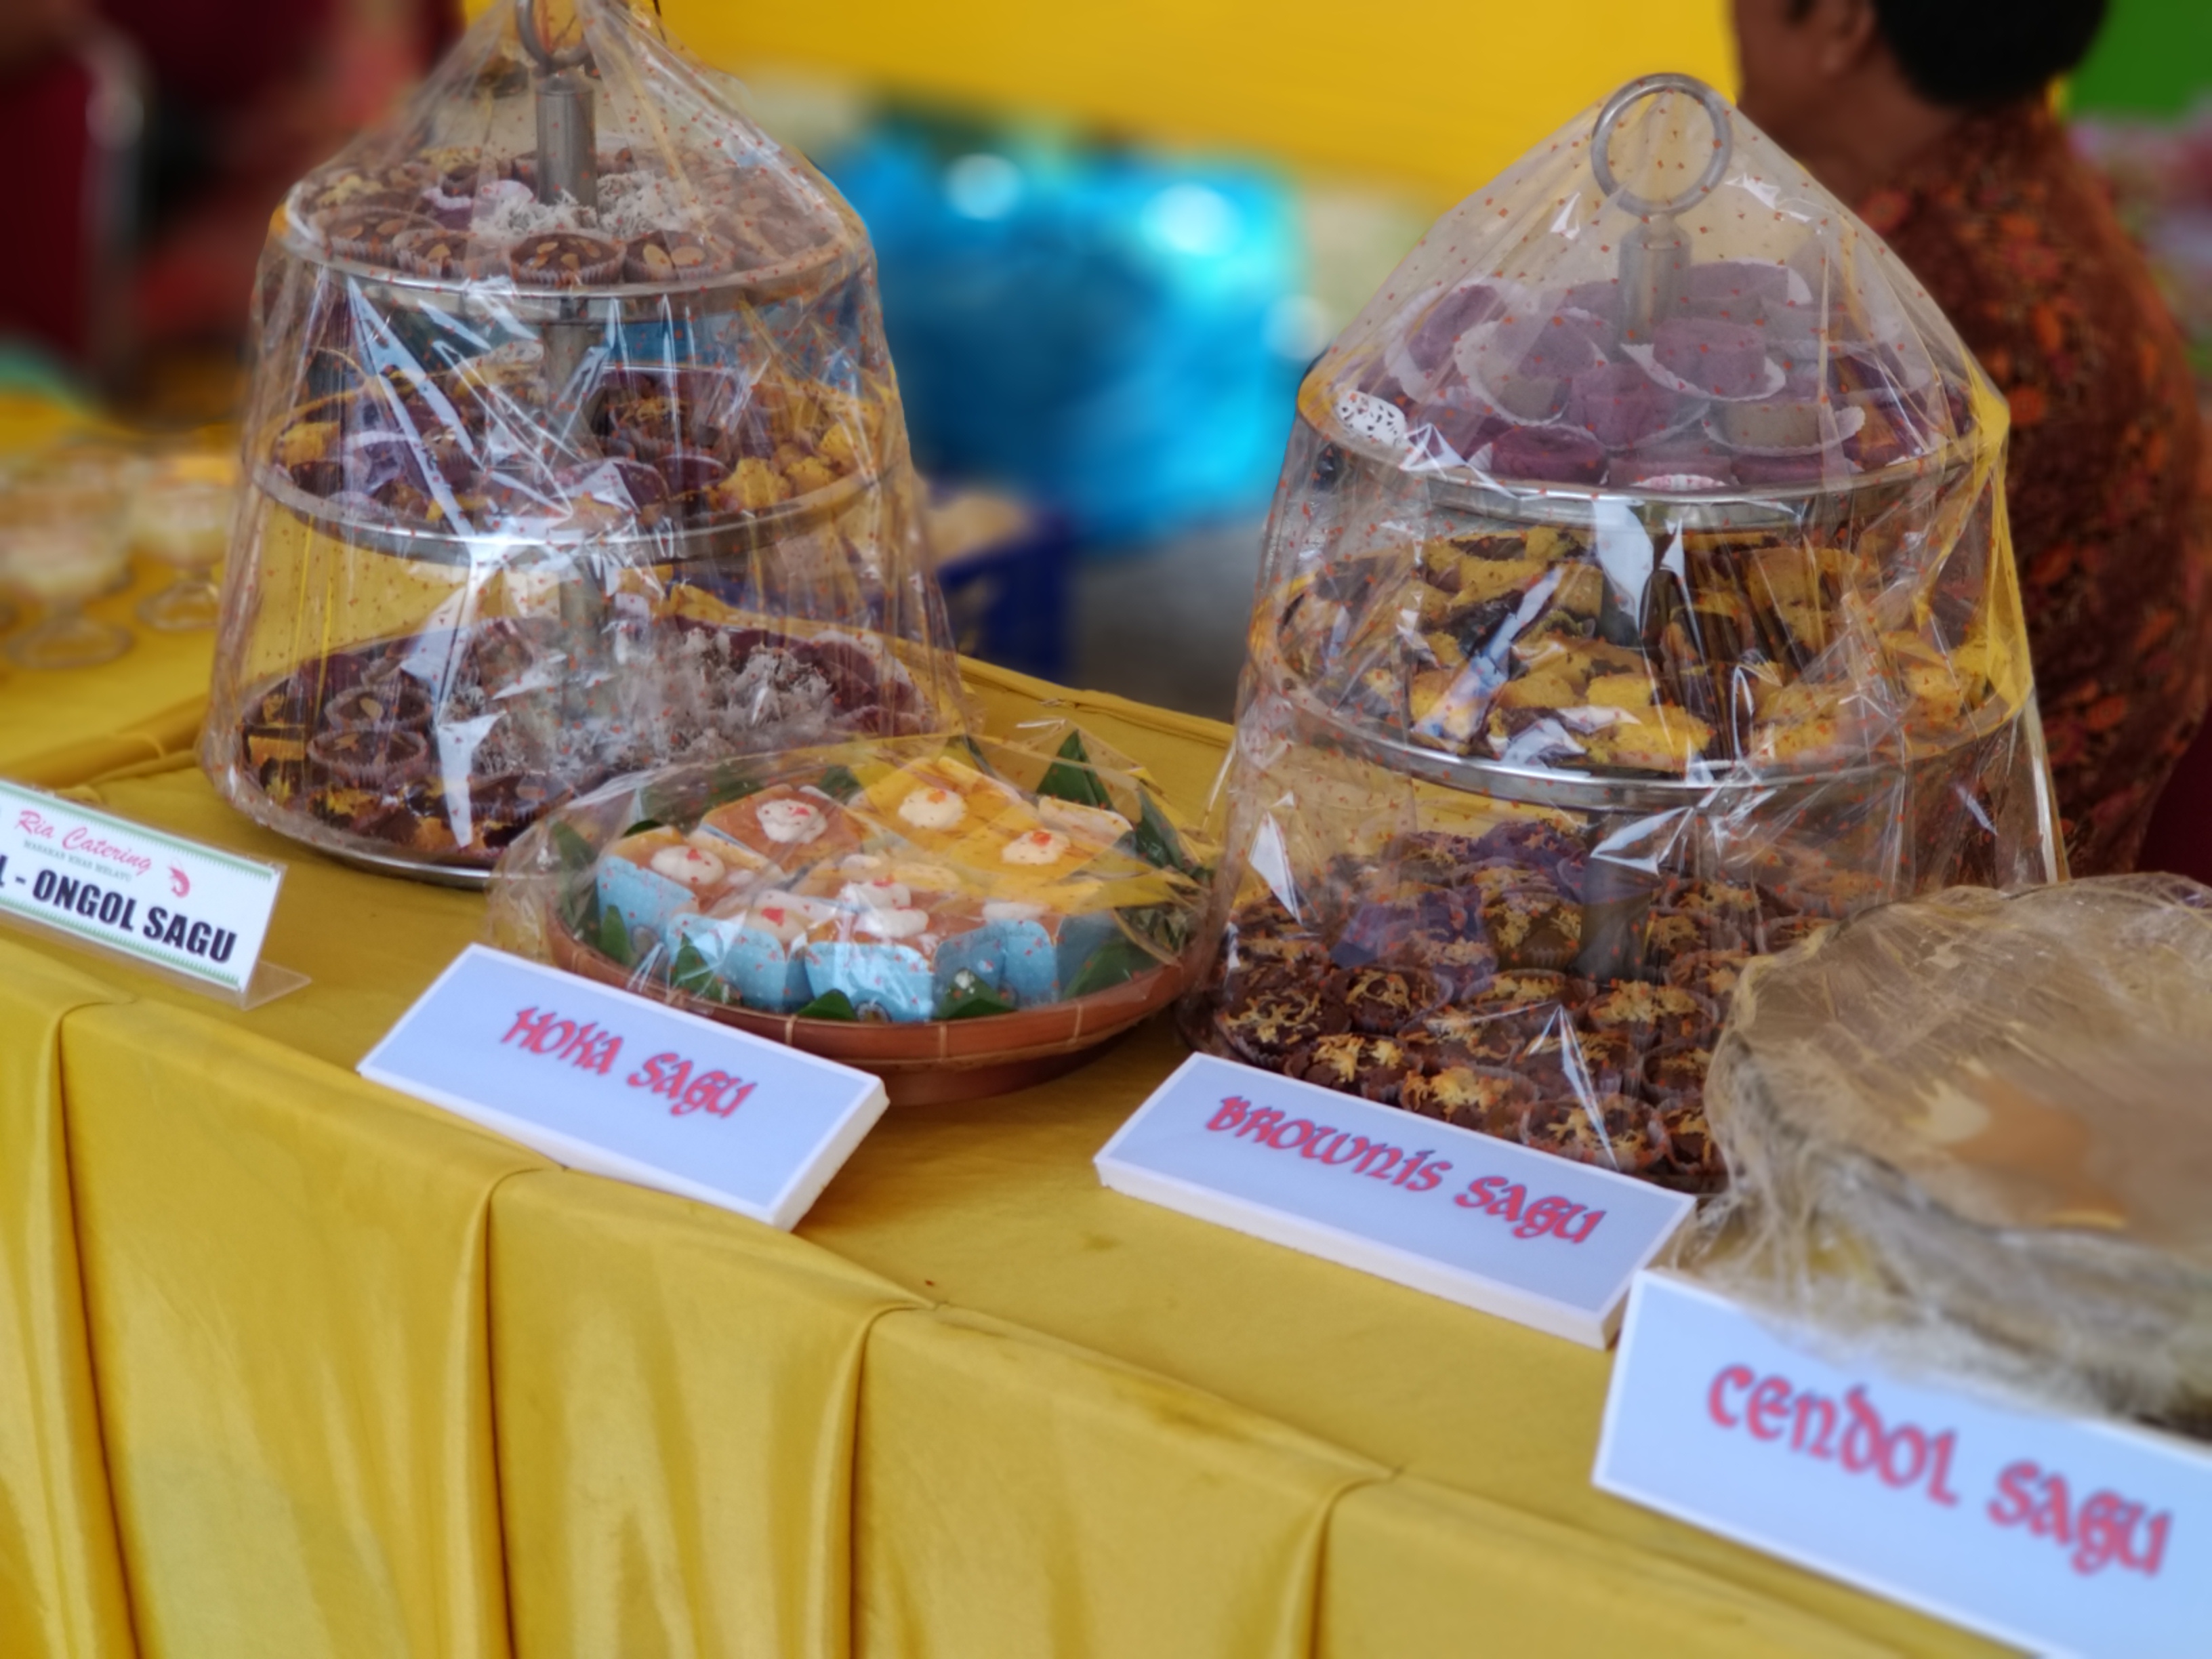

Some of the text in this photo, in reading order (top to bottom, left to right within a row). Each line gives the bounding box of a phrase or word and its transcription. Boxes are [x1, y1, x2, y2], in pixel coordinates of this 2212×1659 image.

[15, 809, 152, 876] Ria Catering
[33, 869, 136, 932] ONGOL
[142, 906, 237, 963] SAGU
[626, 1051, 757, 1118] SAGU
[1454, 1174, 1607, 1244] SAGU
[1987, 1460, 2172, 1578] SAGU
